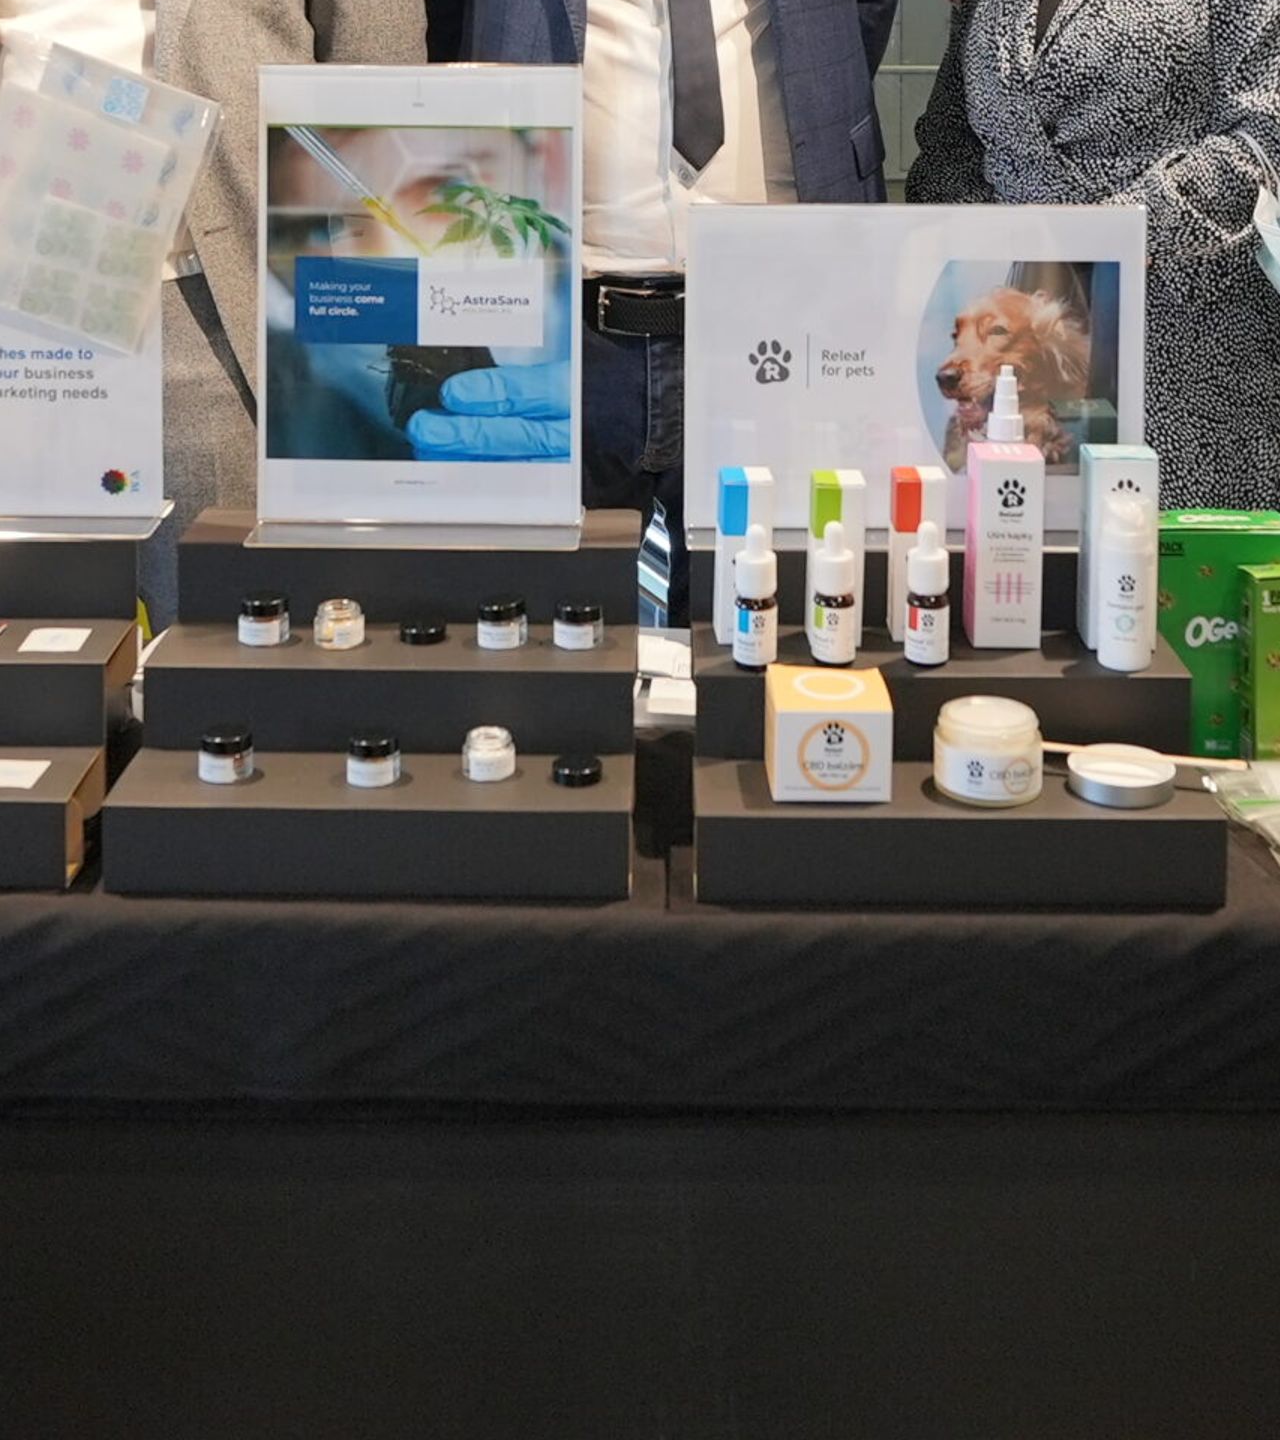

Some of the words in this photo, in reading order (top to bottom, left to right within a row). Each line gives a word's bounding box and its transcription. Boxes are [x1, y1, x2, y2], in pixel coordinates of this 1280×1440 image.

[308, 281, 348, 293] Making
[348, 283, 371, 293] your
[308, 294, 353, 304] business
[354, 295, 385, 304] come
[462, 295, 530, 306] AstraSana
[308, 306, 327, 316] full
[327, 306, 360, 317] circle.
[30, 347, 73, 360] made
[78, 348, 94, 360] to
[821, 349, 866, 362] Releaf
[23, 366, 95, 380] business
[821, 364, 842, 377] for
[845, 365, 875, 379] pets
[62, 386, 108, 400] needs
[1184, 616, 1239, 648] OGe
